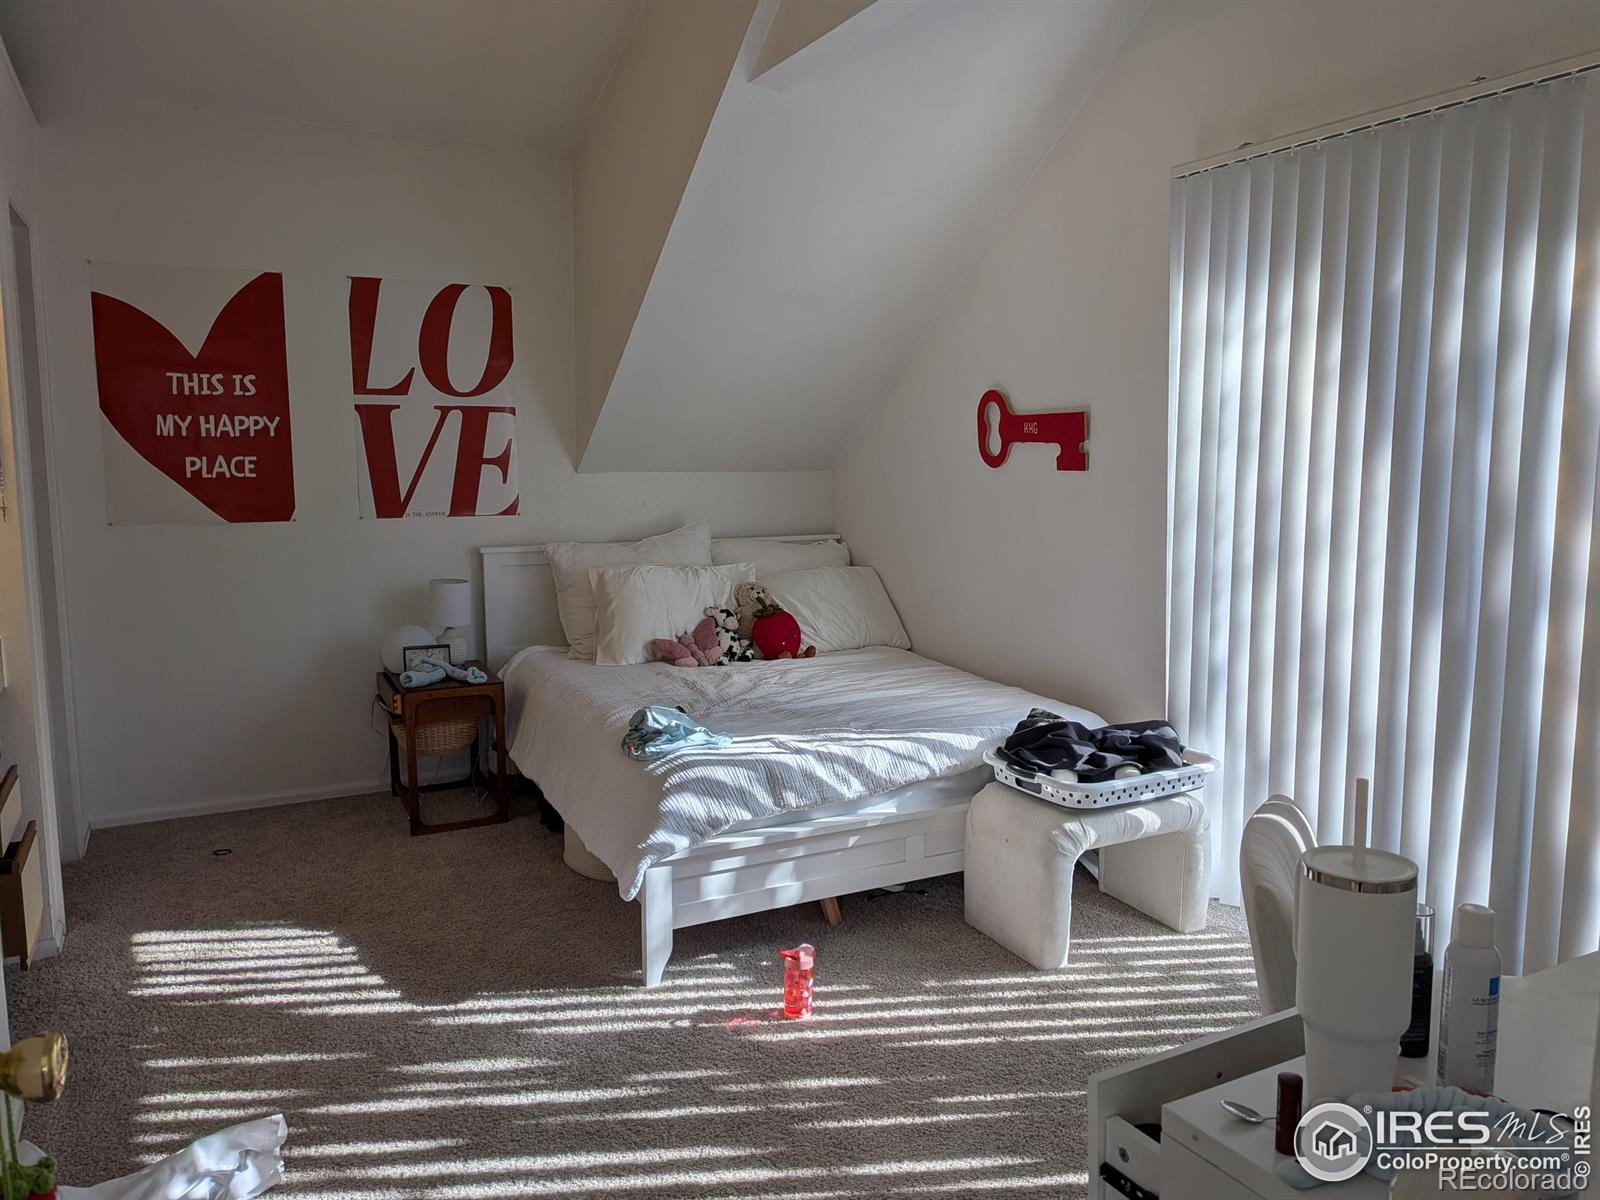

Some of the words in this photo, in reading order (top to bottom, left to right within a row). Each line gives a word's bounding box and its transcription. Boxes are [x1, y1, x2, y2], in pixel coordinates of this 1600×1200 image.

[166, 372, 224, 396] THIS
[233, 374, 256, 396] IS
[156, 414, 190, 437] MY
[199, 415, 280, 438] HAPPY
[185, 456, 257, 479] PLACE
